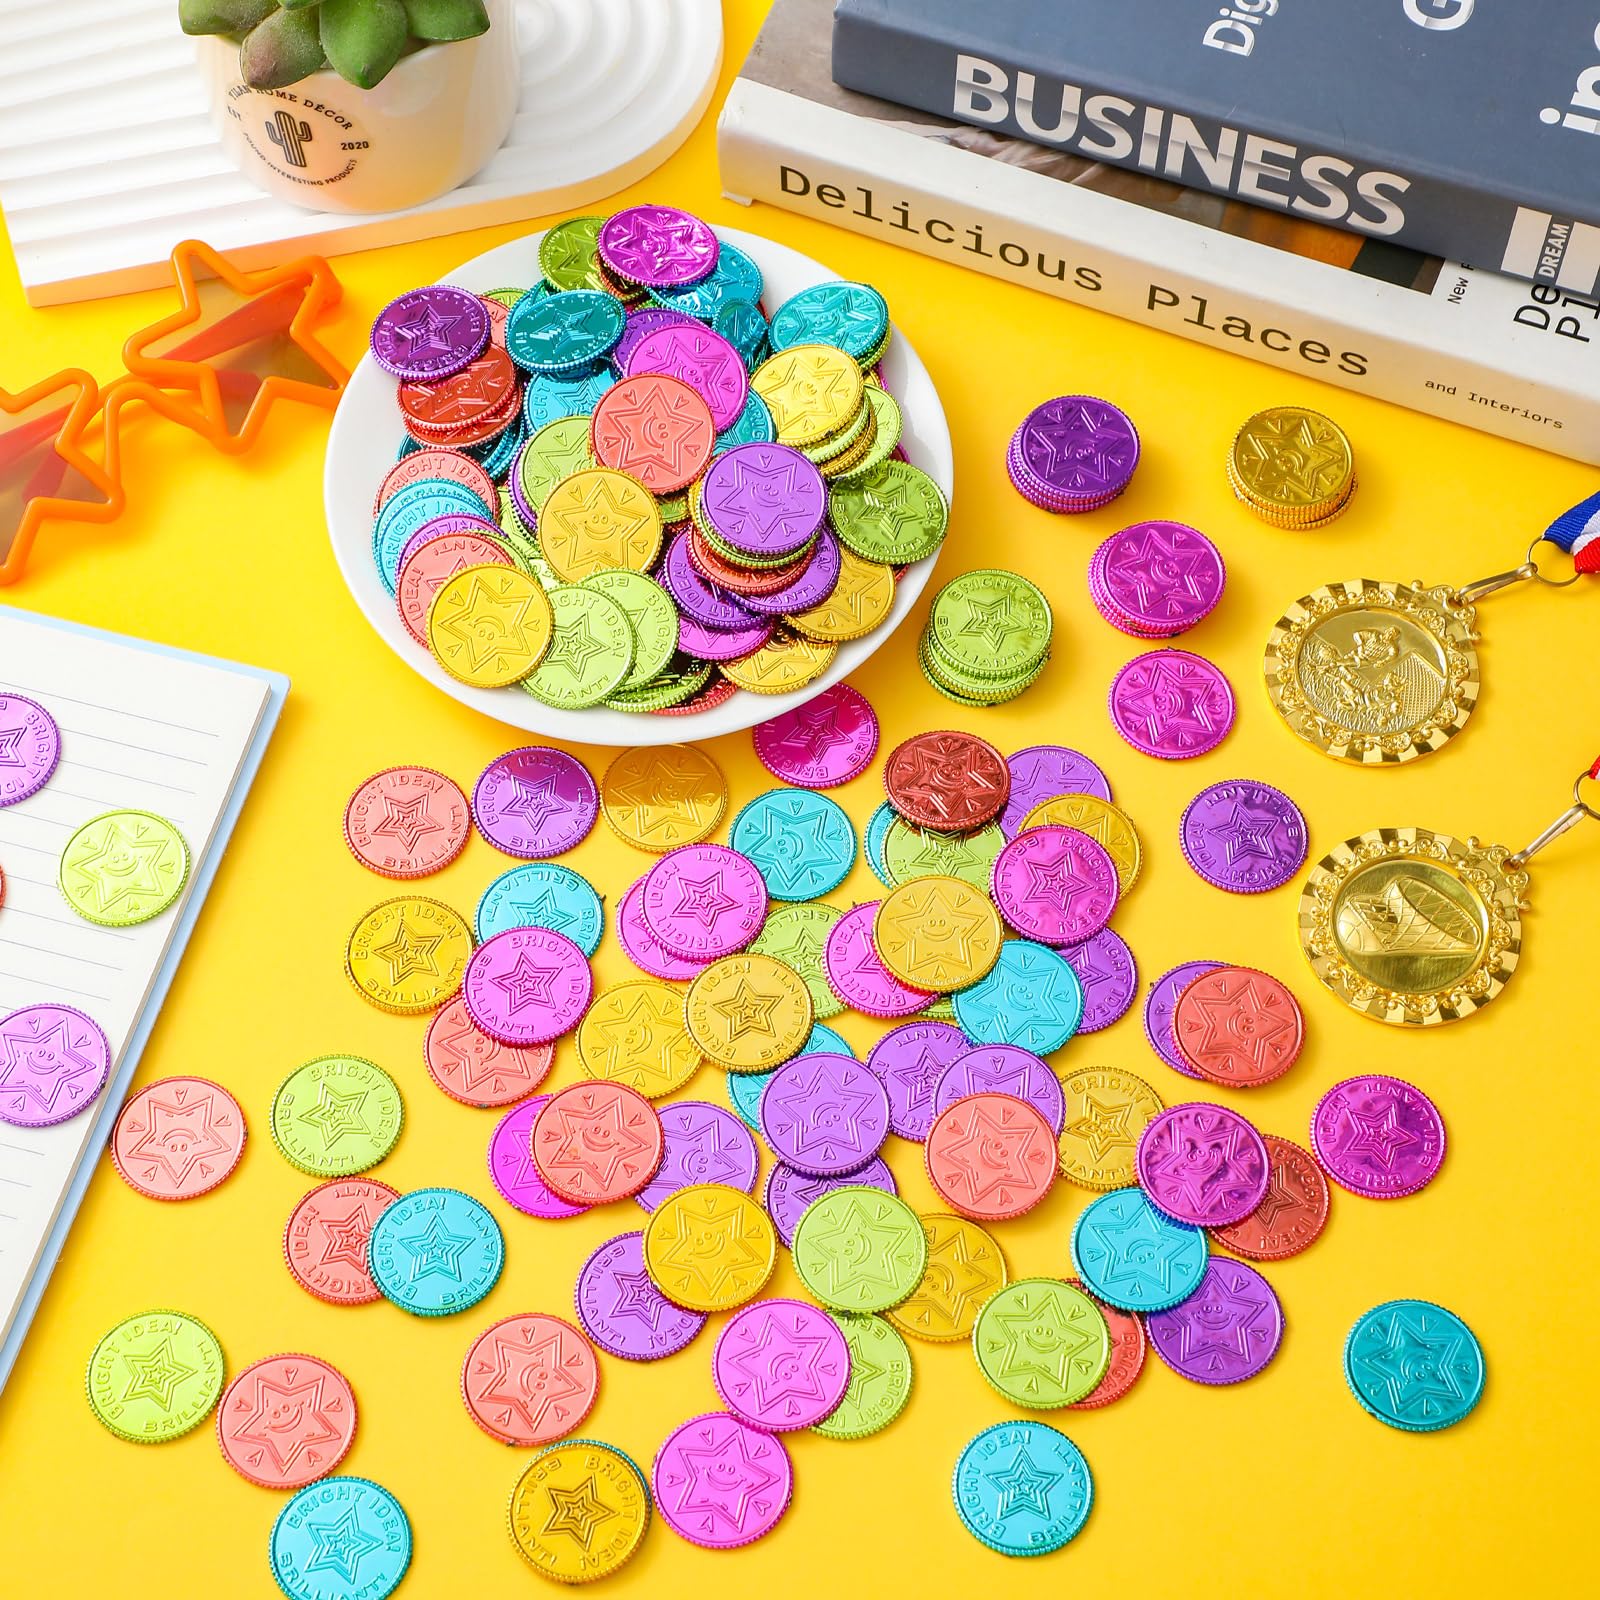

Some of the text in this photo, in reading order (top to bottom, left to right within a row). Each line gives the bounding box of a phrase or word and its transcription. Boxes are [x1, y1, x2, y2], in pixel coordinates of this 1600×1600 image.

[304, 99, 352, 130] DÉCOR
[340, 141, 369, 150] 2020
[952, 53, 1413, 237] BUSINESS
[325, 159, 357, 185] PRODUCTS
[780, 165, 1368, 377] Delicious Places
[1448, 278, 1469, 304] New
[1538, 223, 1569, 278] DREAM
[1425, 379, 1563, 429] and Interiors
[24, 711, 50, 779] BRIGHT
[353, 774, 445, 848] BRIGHT IDEA!
[383, 803, 462, 870] BRILLIANT!
[353, 904, 462, 961] BRIGHT IDEA!
[649, 862, 724, 950] BRIGHT IDEA!
[471, 953, 535, 1035] BRILLIANT!
[509, 933, 584, 1024] BRIGHT IDEA!
[833, 916, 907, 1007] BRIGHT IDEA!
[692, 961, 751, 1060] BRIGHT IDEA!
[278, 1093, 355, 1167] BRILLIANT!
[308, 1062, 395, 1149] BRIGHT IDEA!
[1070, 1075, 1149, 1104] BRIGHT
[294, 1205, 320, 1259] IDEA!
[377, 1196, 447, 1300] BRIGHT IDEA!
[439, 1208, 494, 1305] BRILLIANT!
[584, 1245, 626, 1345] BRILLIANT!
[95, 1319, 182, 1420] BRIGHT IDEA!
[143, 1339, 218, 1433] BRILLIANT!
[855, 1360, 903, 1427] BRIGHT
[287, 1486, 401, 1552] BRIGHT IDEA!
[516, 1457, 561, 1565] BRILLIANT!
[580, 1455, 637, 1570] BRIGHT IDEA!
[964, 1430, 1032, 1539] BRIGHT IDEA!
[1028, 1443, 1085, 1545] BRILLIANT!
